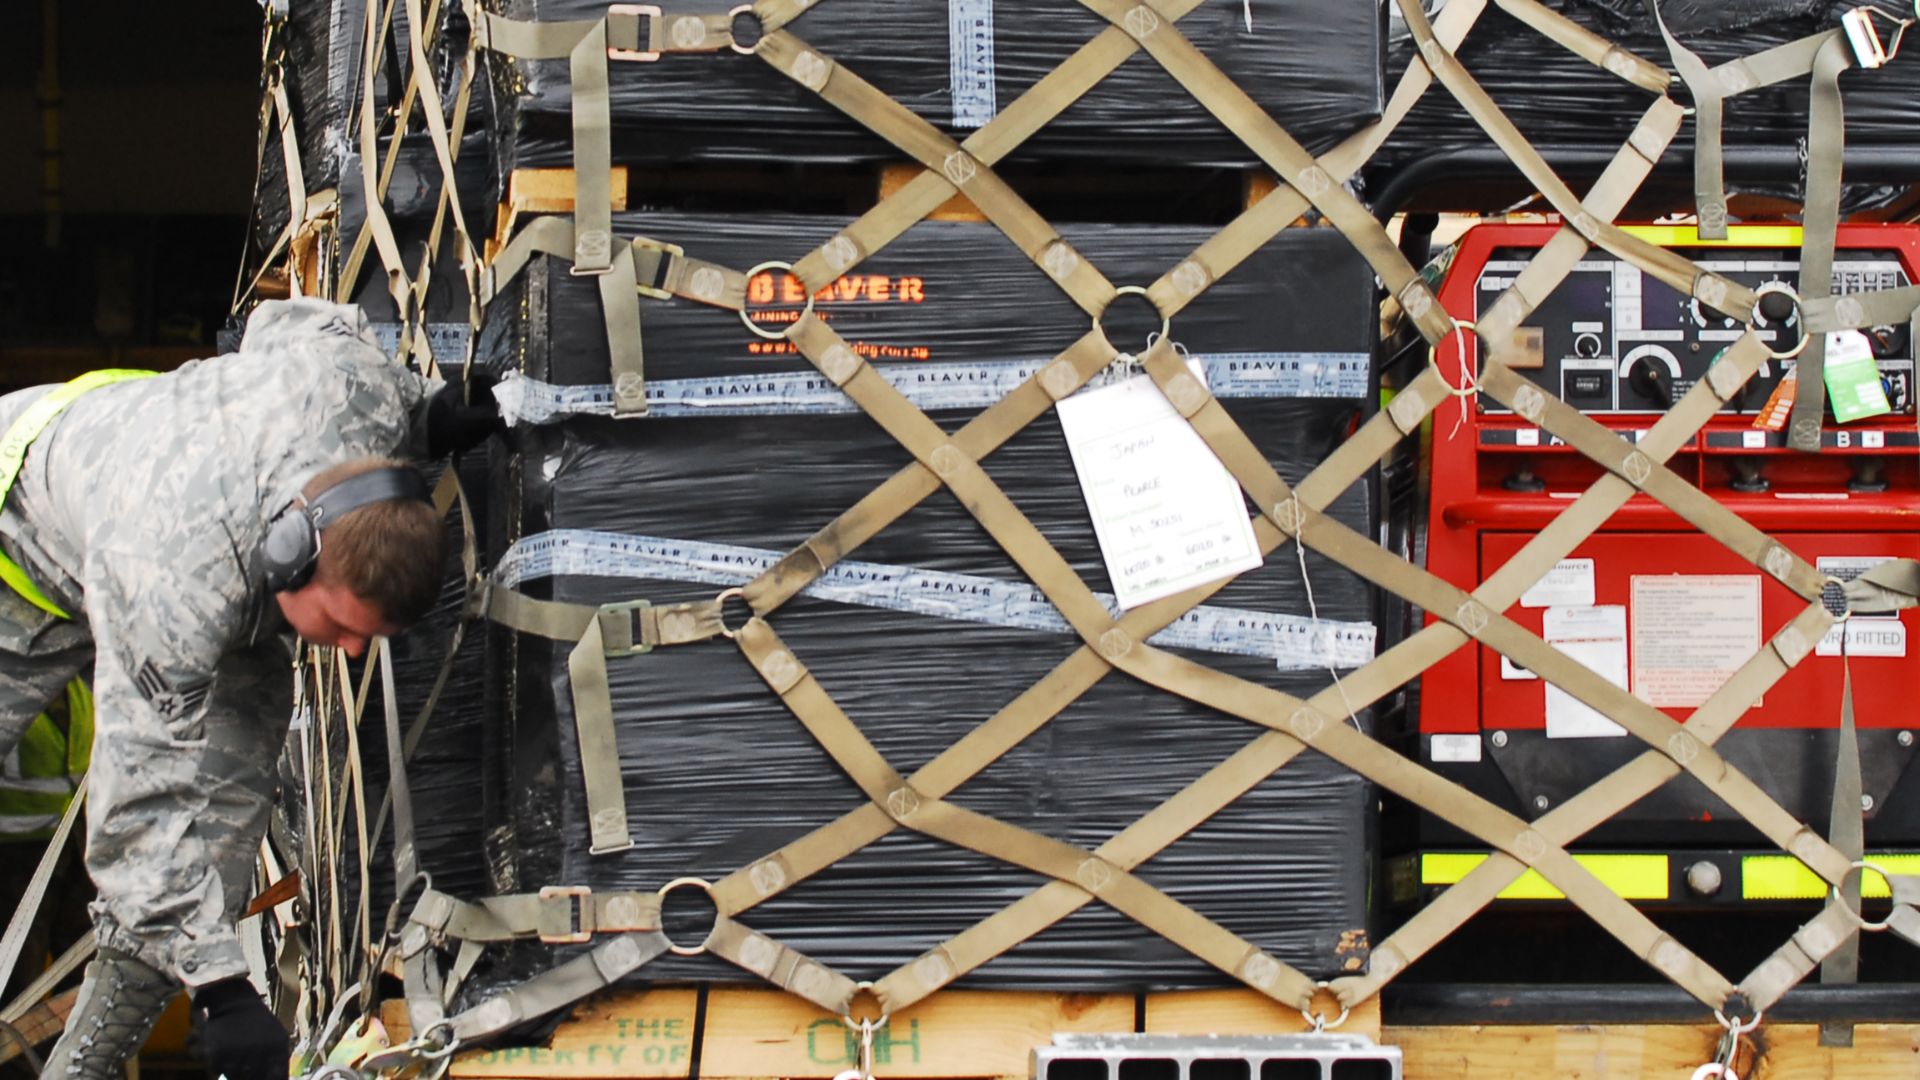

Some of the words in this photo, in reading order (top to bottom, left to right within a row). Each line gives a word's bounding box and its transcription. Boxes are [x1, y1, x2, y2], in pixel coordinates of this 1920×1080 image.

[975, 20, 987, 90] BEAVER
[749, 271, 926, 303] BEAVER
[395, 330, 460, 340] BVER
[1229, 361, 1300, 371] BEAVER
[593, 390, 666, 403] BEER
[704, 383, 776, 396] BEAVER
[917, 370, 988, 383] BEAVER
[1836, 431, 1850, 448] B
[609, 541, 681, 557] BEAVER
[711, 553, 779, 570] BEAVE
[920, 579, 991, 597] BEAVER
[1238, 619, 1307, 634] BEAVER
[1856, 631, 1901, 646] FITTED
[615, 1017, 685, 1040] THE
[643, 1044, 689, 1066] OF
